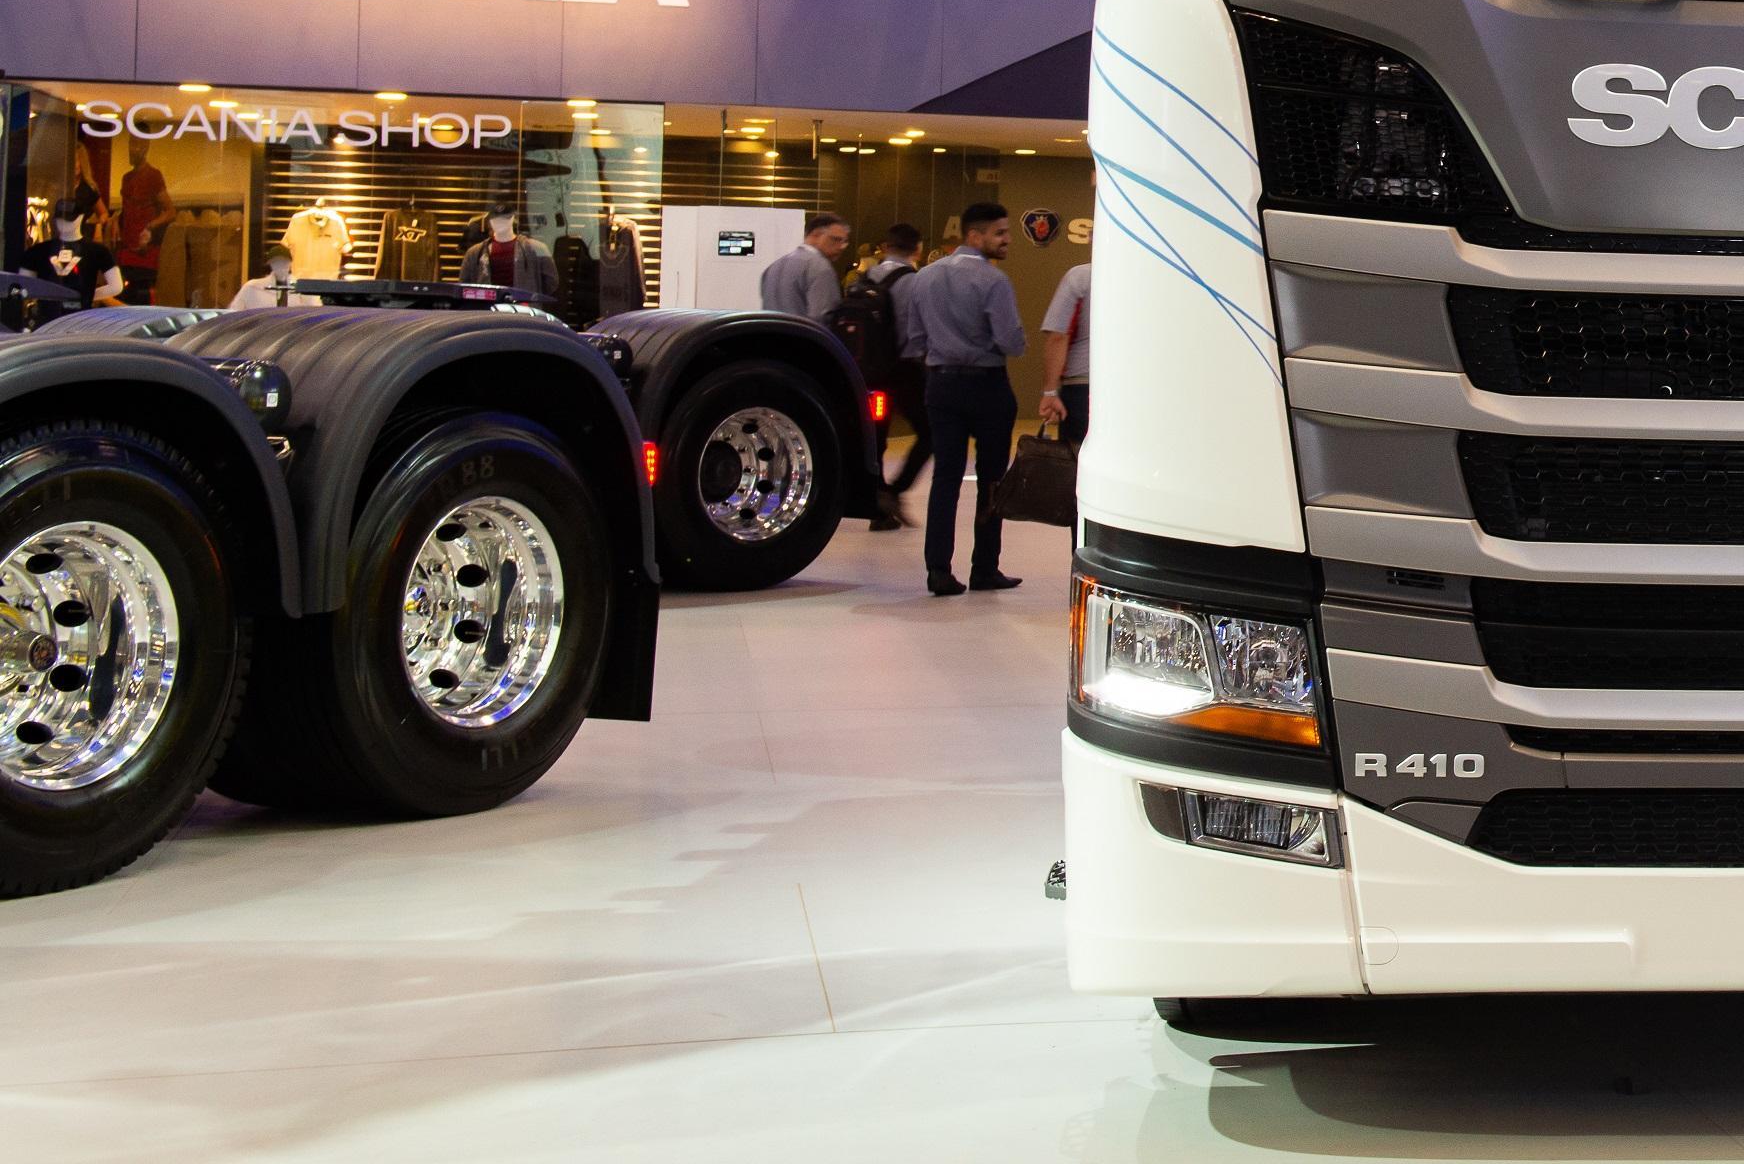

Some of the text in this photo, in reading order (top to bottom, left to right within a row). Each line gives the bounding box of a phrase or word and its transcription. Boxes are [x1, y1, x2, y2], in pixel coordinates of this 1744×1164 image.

[81, 100, 512, 149] SCANIA SHOP
[1355, 753, 1485, 778] R 410
